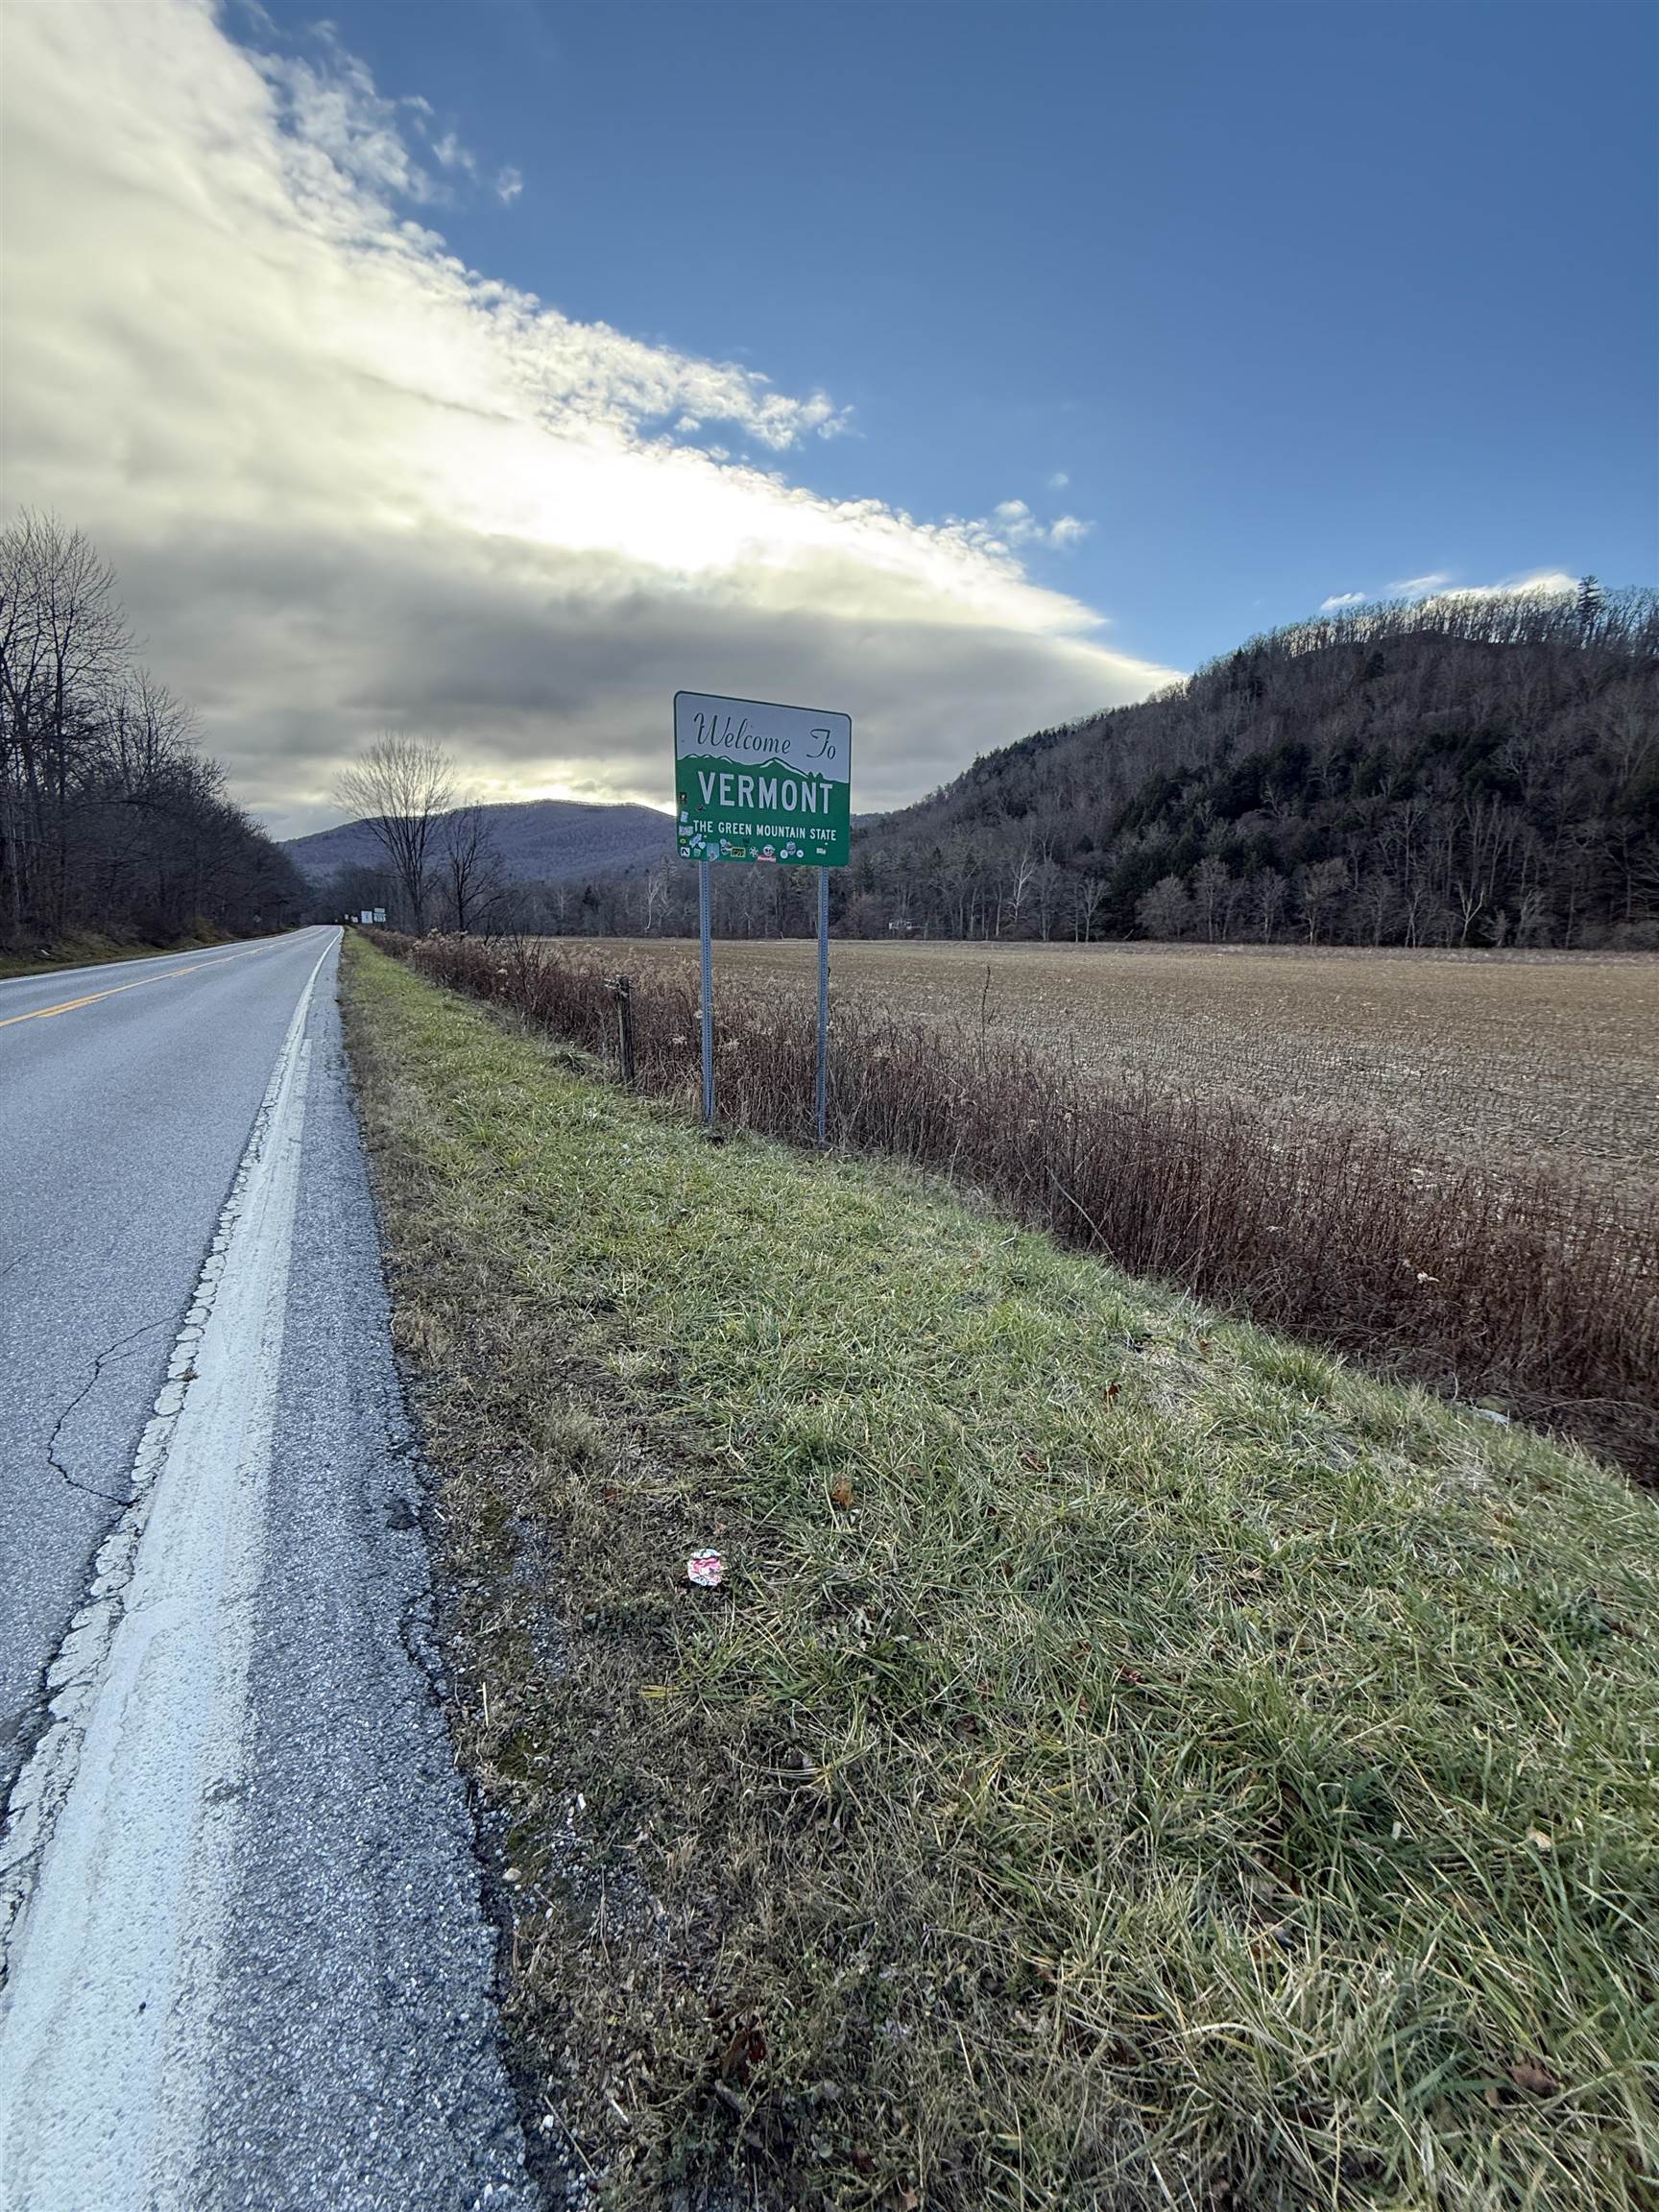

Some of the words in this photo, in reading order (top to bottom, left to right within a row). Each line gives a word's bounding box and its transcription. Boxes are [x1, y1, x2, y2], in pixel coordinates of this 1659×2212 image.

[693, 712, 791, 755] Welcome
[806, 729, 836, 760] To
[697, 771, 833, 814] VERMONT
[693, 820, 713, 833] THE
[718, 821, 752, 835] GREEN
[757, 824, 806, 839] MOUNTAIN
[809, 828, 837, 842] STATE
